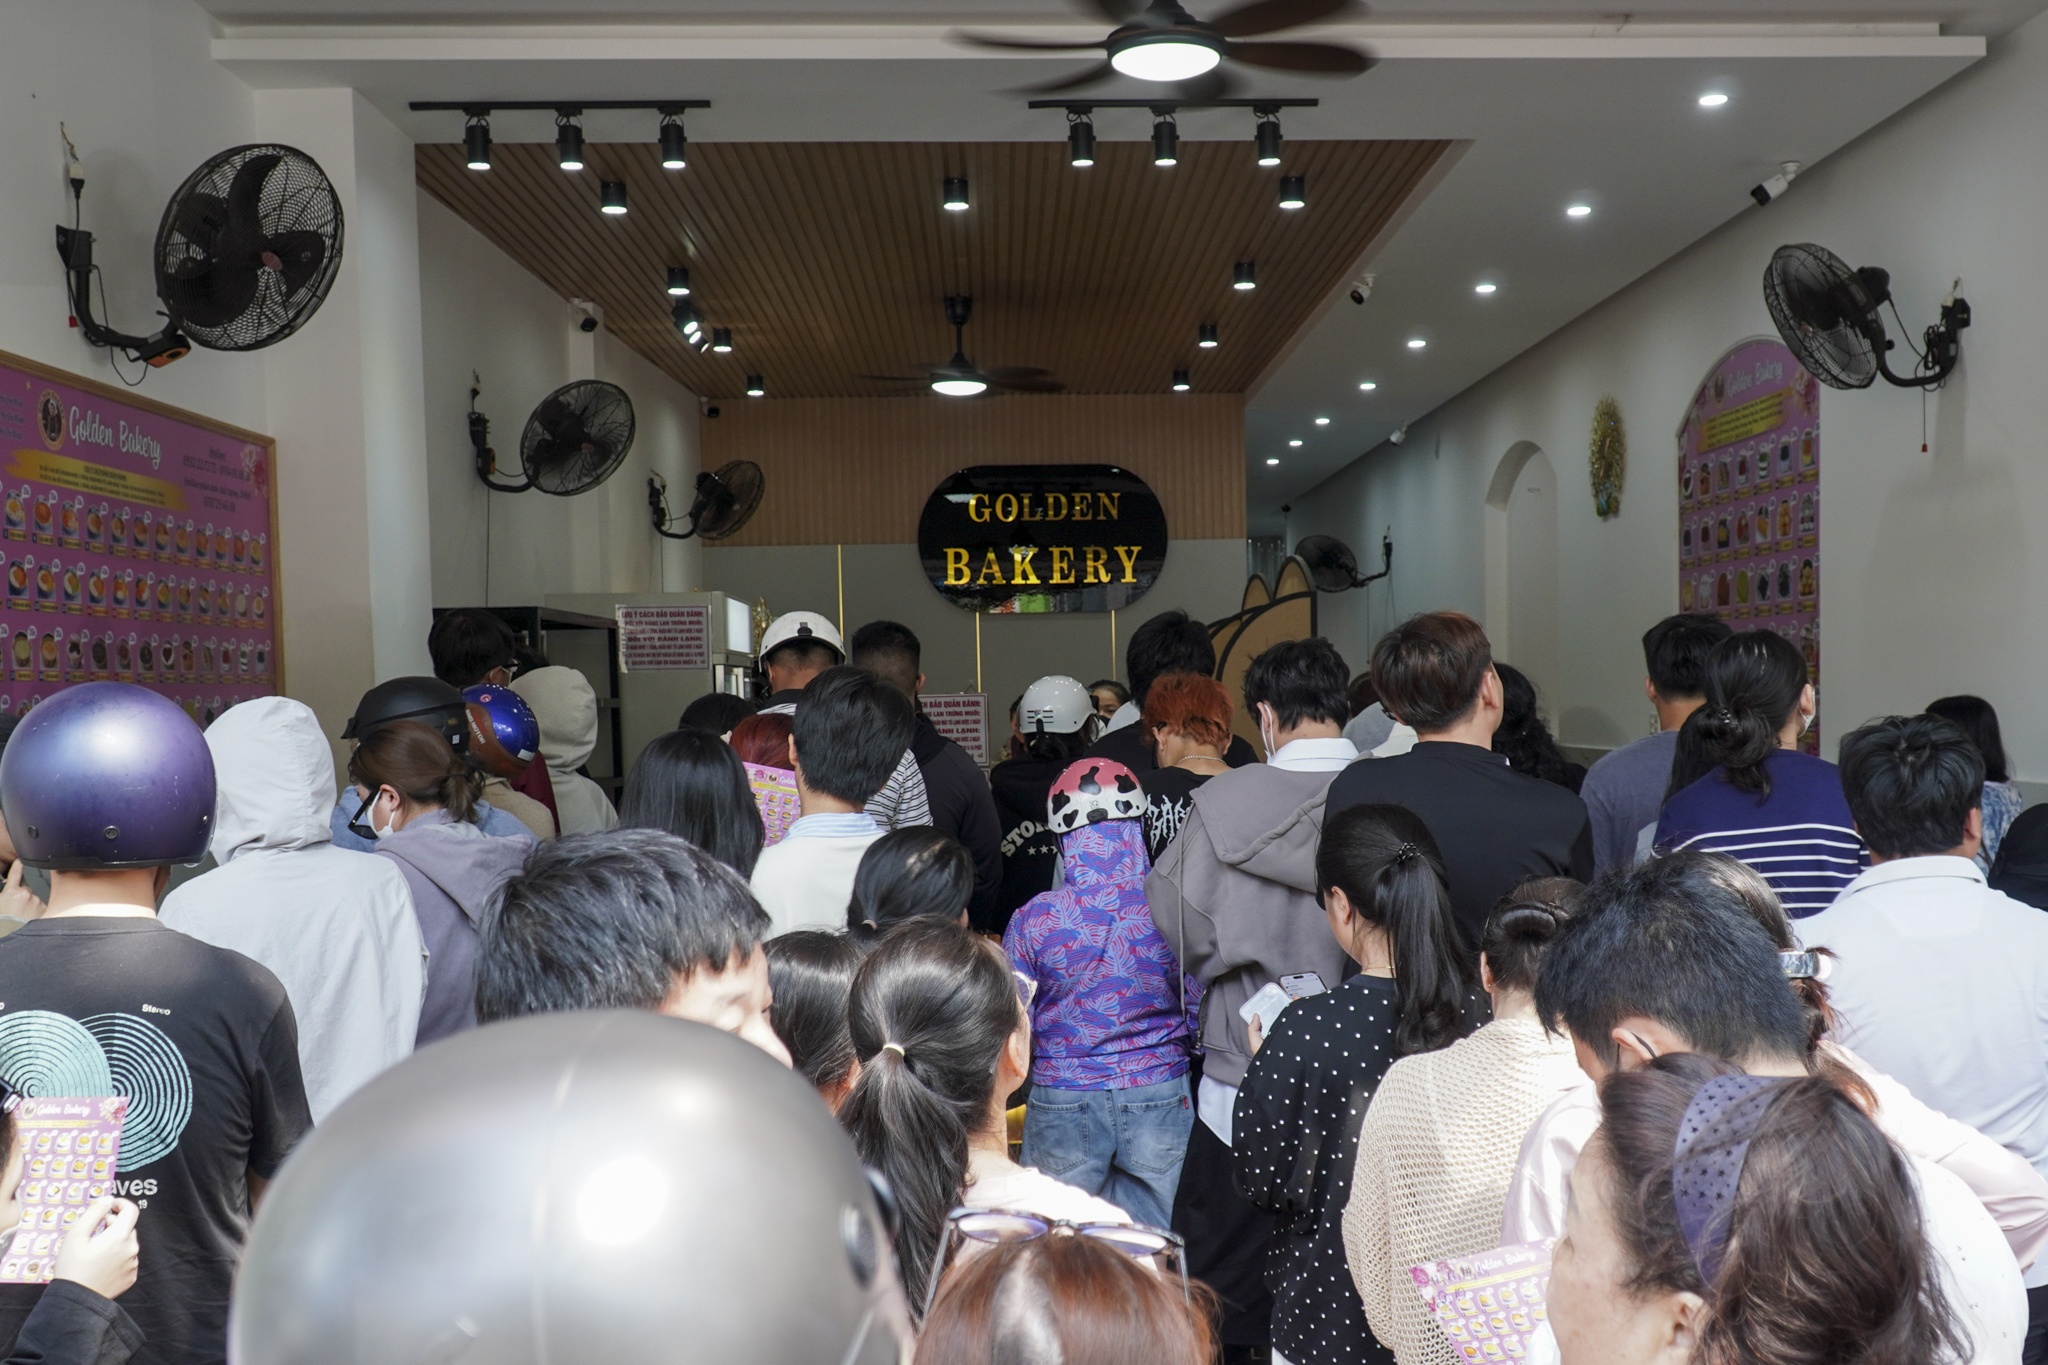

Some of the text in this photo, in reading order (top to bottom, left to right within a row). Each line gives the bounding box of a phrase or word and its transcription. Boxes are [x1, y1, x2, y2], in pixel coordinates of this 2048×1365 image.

[68, 406, 114, 448] Golden
[119, 420, 162, 471] Bakery
[968, 492, 1121, 522] GOLDEN
[943, 545, 1142, 586] BAKERY
[639, 610, 655, 618] CÁCH
[656, 610, 668, 618] BẢO
[669, 610, 685, 618] QUẢN
[929, 699, 942, 709] BẢO
[943, 698, 961, 709] QUẢN
[962, 698, 982, 708] BÁNH:
[470, 721, 486, 745] MOTOR
[955, 727, 981, 735] LẠNH:
[779, 776, 797, 786] Golde
[141, 1003, 171, 1016] Stereo
[36, 1103, 91, 1118] Golden Bakery
[1474, 1258, 1504, 1273] Golden
[1505, 1251, 1537, 1266] Bakery
